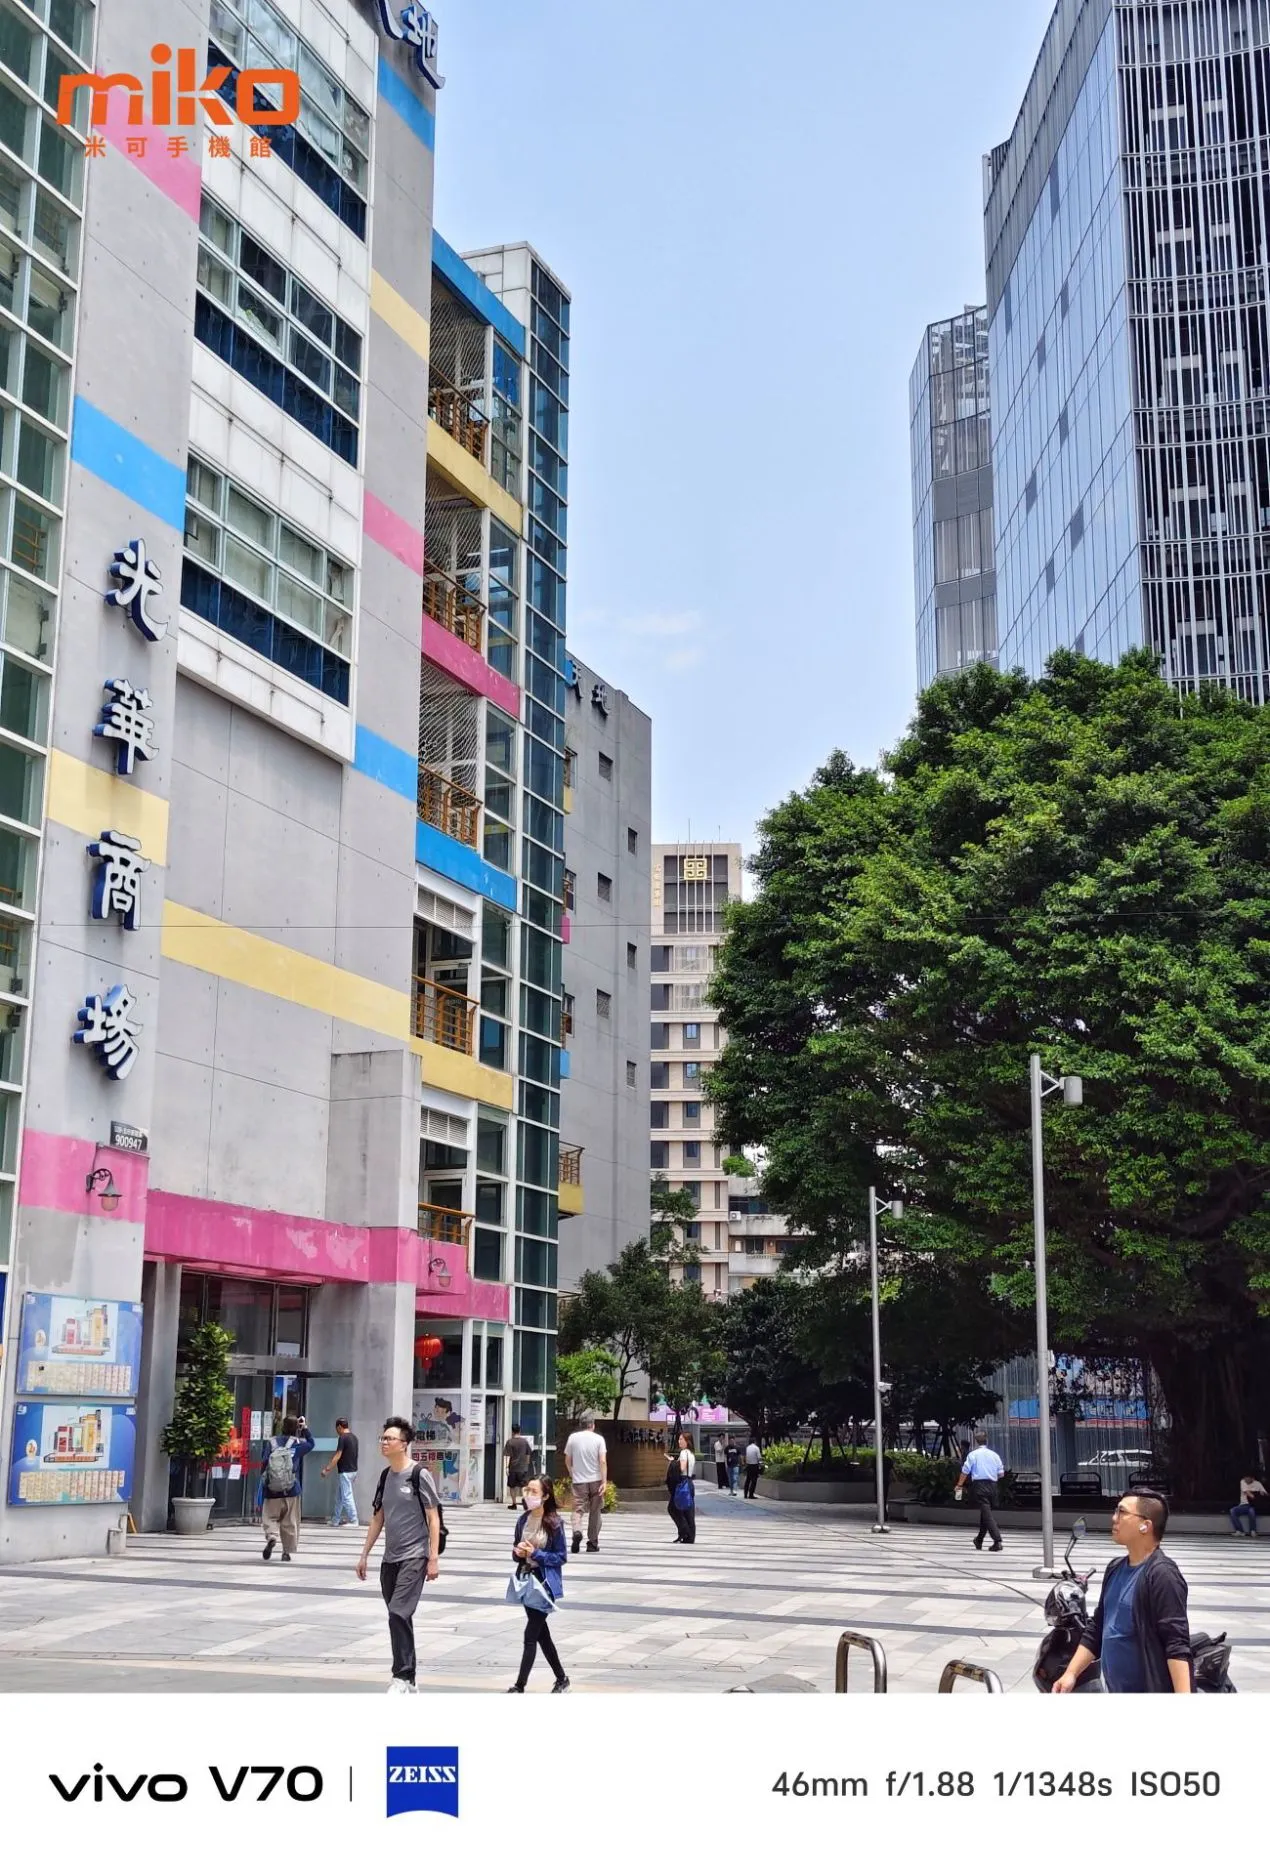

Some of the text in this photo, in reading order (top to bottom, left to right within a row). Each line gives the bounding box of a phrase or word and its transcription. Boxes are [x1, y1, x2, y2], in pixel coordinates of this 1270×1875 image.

[72, 537, 169, 1081] 光華商場
[115, 1134, 143, 1151] 900947
